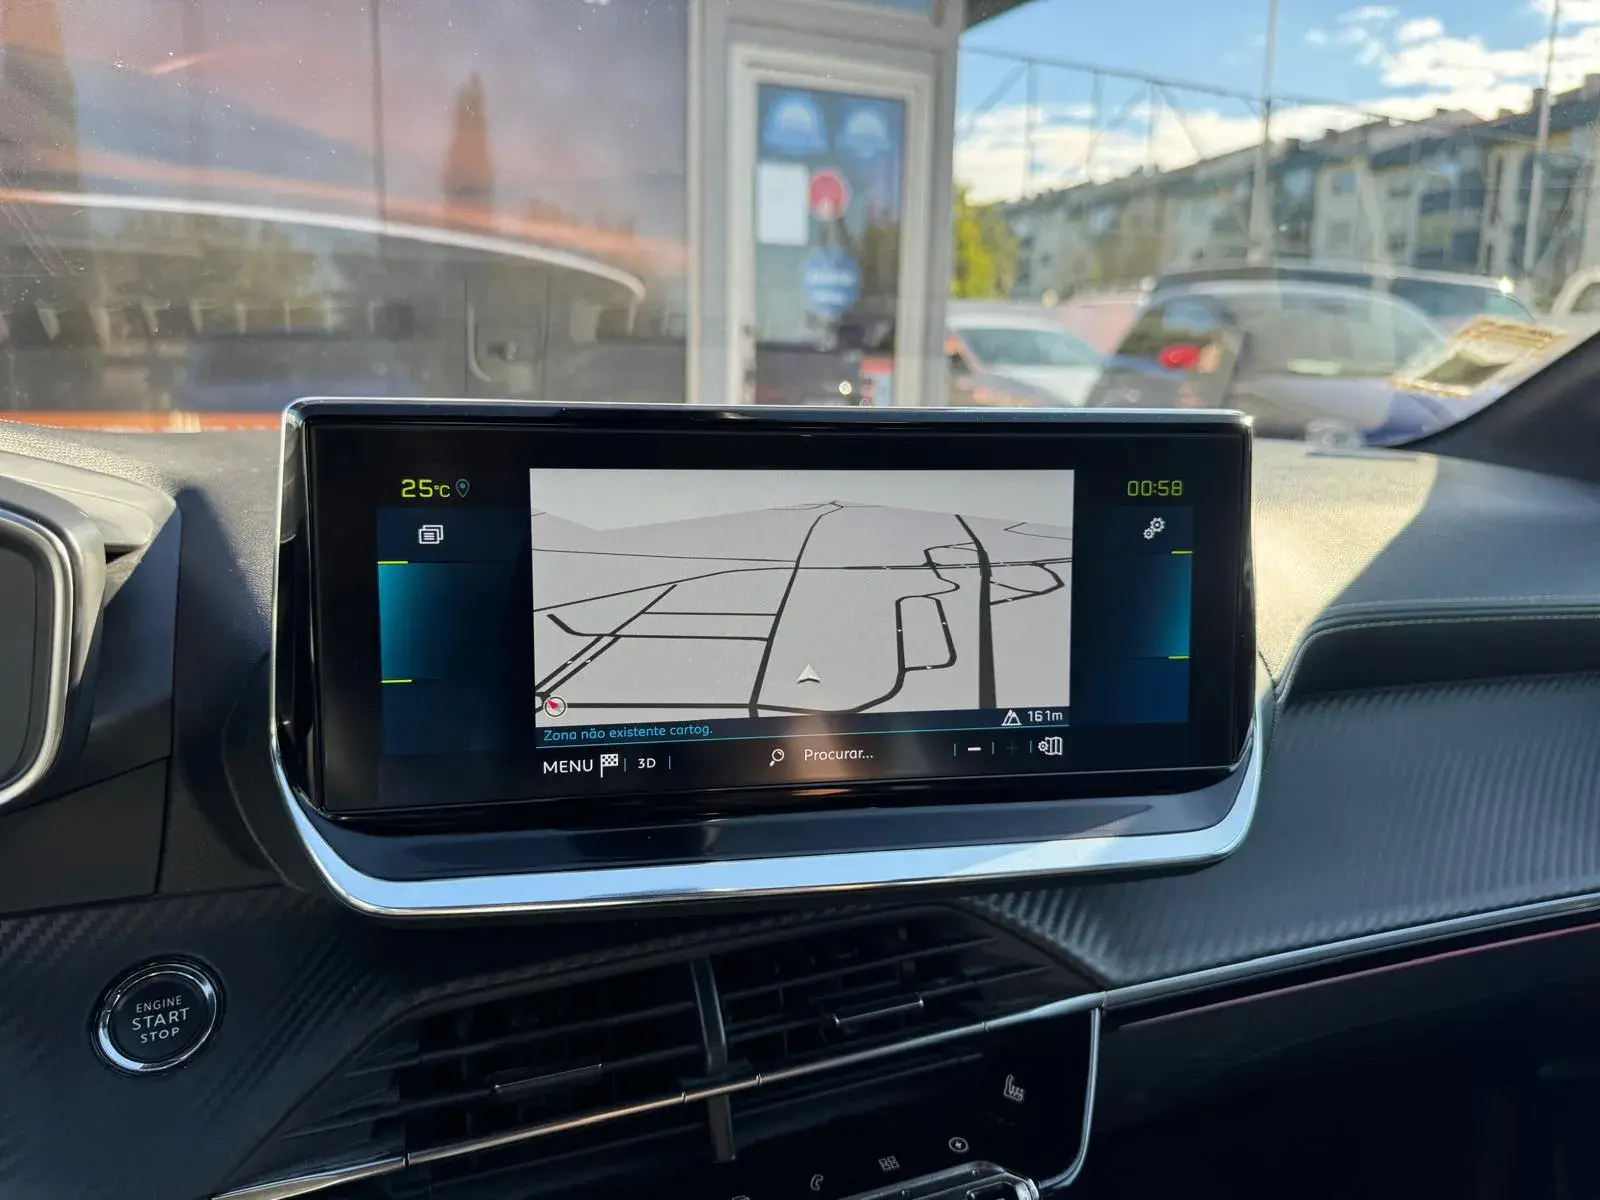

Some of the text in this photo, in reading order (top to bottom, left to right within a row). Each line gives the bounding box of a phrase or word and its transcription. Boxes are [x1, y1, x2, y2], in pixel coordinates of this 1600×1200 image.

[1126, 479, 1183, 497] 00:58
[1027, 709, 1064, 723] 161m
[543, 724, 713, 742] Zona não existente cartog.
[803, 747, 874, 761] Procurar...
[543, 757, 657, 775] MENU 3D
[135, 994, 182, 1014] ENGINE
[131, 1006, 190, 1031] START
[140, 1026, 180, 1044] STOP
